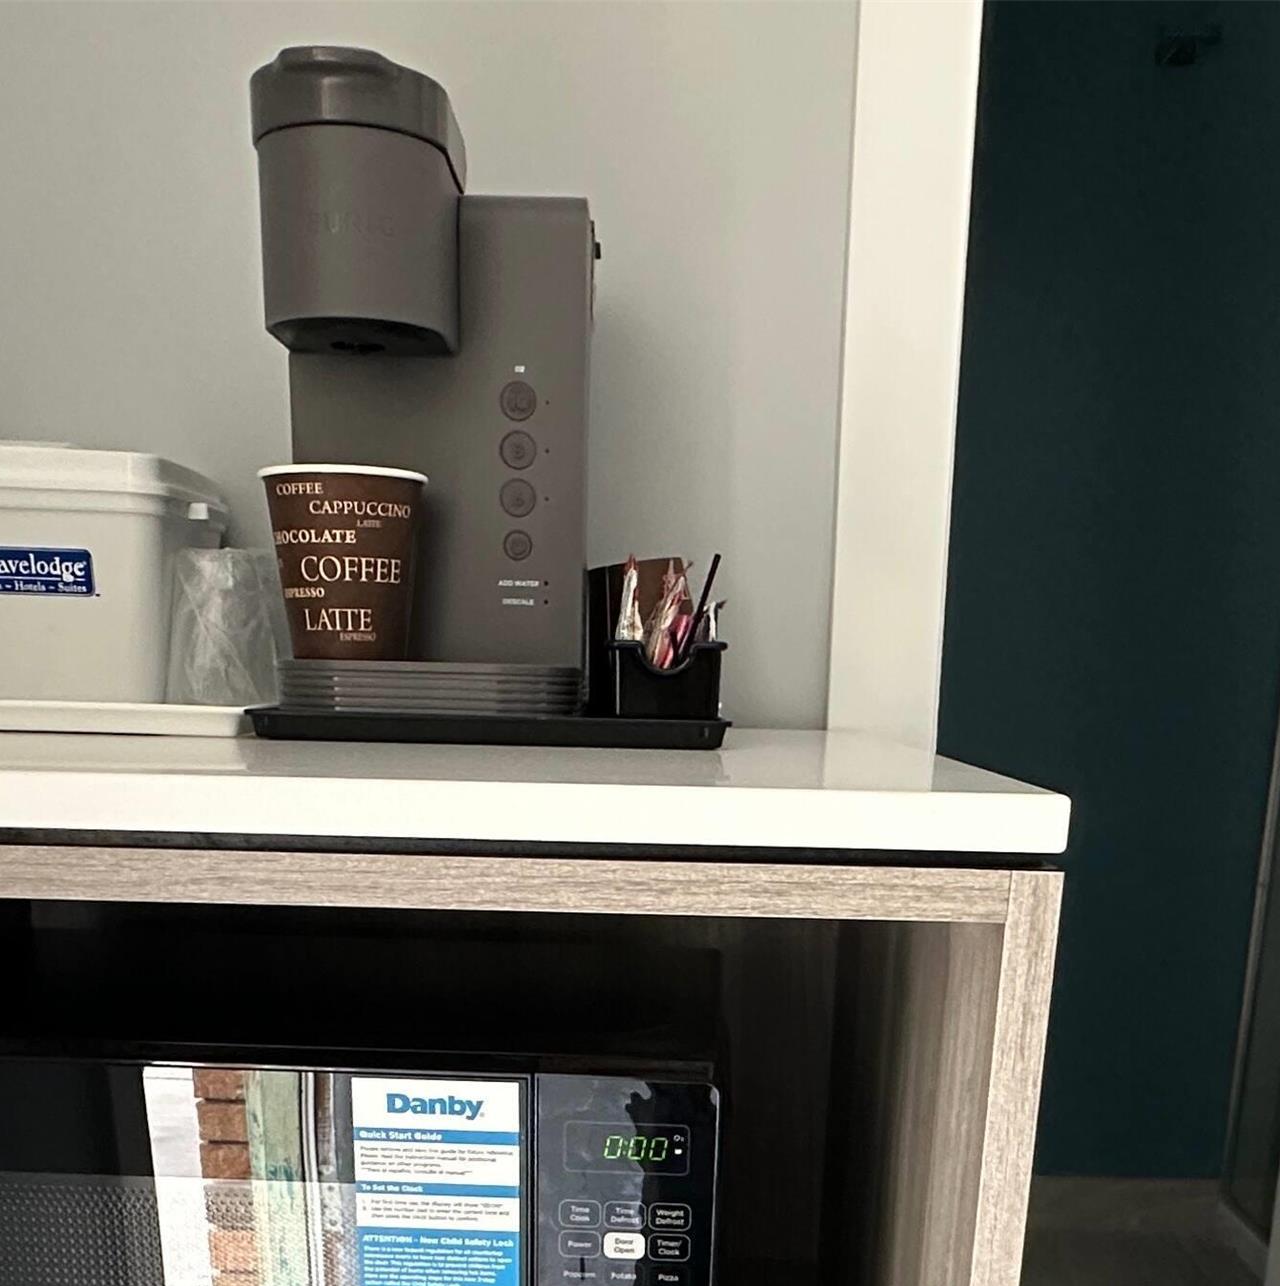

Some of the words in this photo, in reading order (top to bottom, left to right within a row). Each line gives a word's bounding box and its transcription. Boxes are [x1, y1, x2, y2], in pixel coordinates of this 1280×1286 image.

[276, 482, 323, 495] COFFEE
[309, 500, 411, 518] CAPPUCCINO
[273, 529, 357, 545] HOCOLATE
[300, 555, 401, 584] COFFEE
[14, 580, 46, 591] Hotels
[57, 582, 87, 593] Suites
[304, 608, 372, 631] LATTE
[386, 1093, 484, 1121] Danby
[359, 1130, 387, 1140] Quick
[388, 1131, 413, 1140] Start
[414, 1132, 443, 1141] Guide
[604, 1135, 668, 1161] 0:00
[571, 1205, 590, 1213] Time
[615, 1207, 634, 1215] Time
[362, 1234, 413, 1244] ATTENTION
[440, 1237, 463, 1246] Child
[464, 1238, 491, 1248] Safety
[493, 1238, 514, 1248] Lock
[568, 1240, 592, 1249] Power
[658, 1248, 680, 1256] Clock
